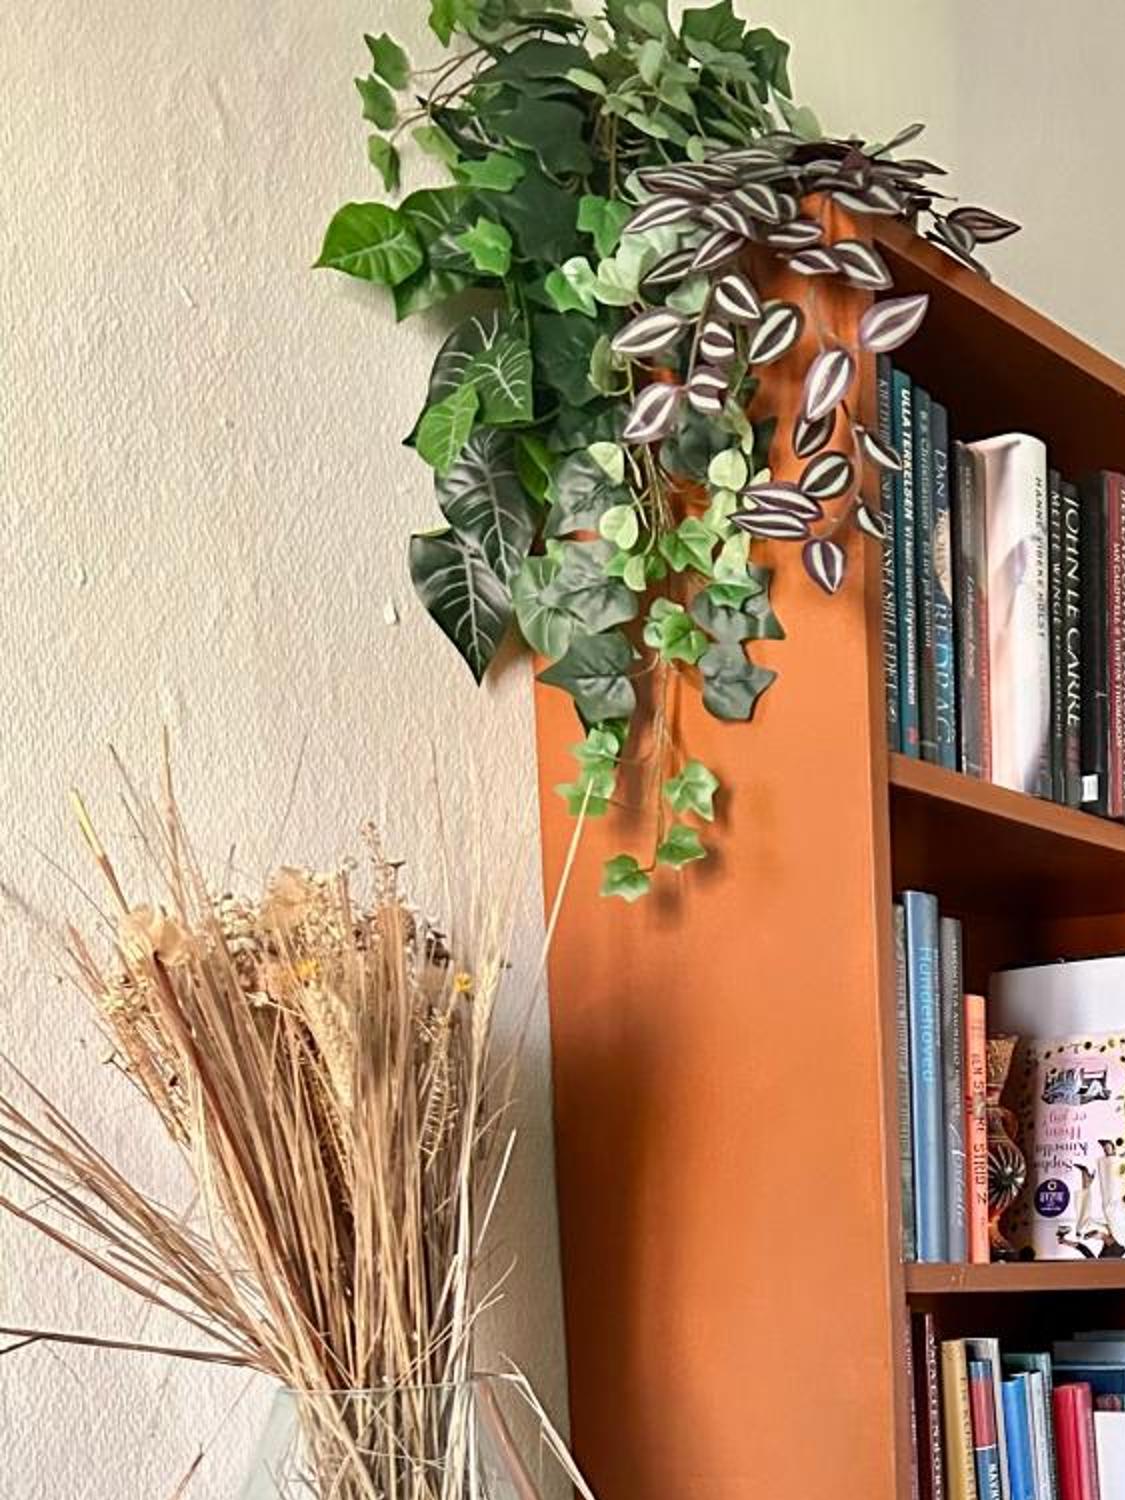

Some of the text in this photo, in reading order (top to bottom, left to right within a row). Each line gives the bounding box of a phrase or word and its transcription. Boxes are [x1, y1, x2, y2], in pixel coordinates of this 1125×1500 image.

[901, 388, 912, 427] ULLA
[902, 432, 914, 520] TERKELSEN
[933, 450, 948, 498] DAN
[1050, 490, 1061, 555] METTE
[1063, 496, 1081, 581] JOHN
[1067, 588, 1080, 619] LE
[920, 945, 938, 1083] Hundehoved
